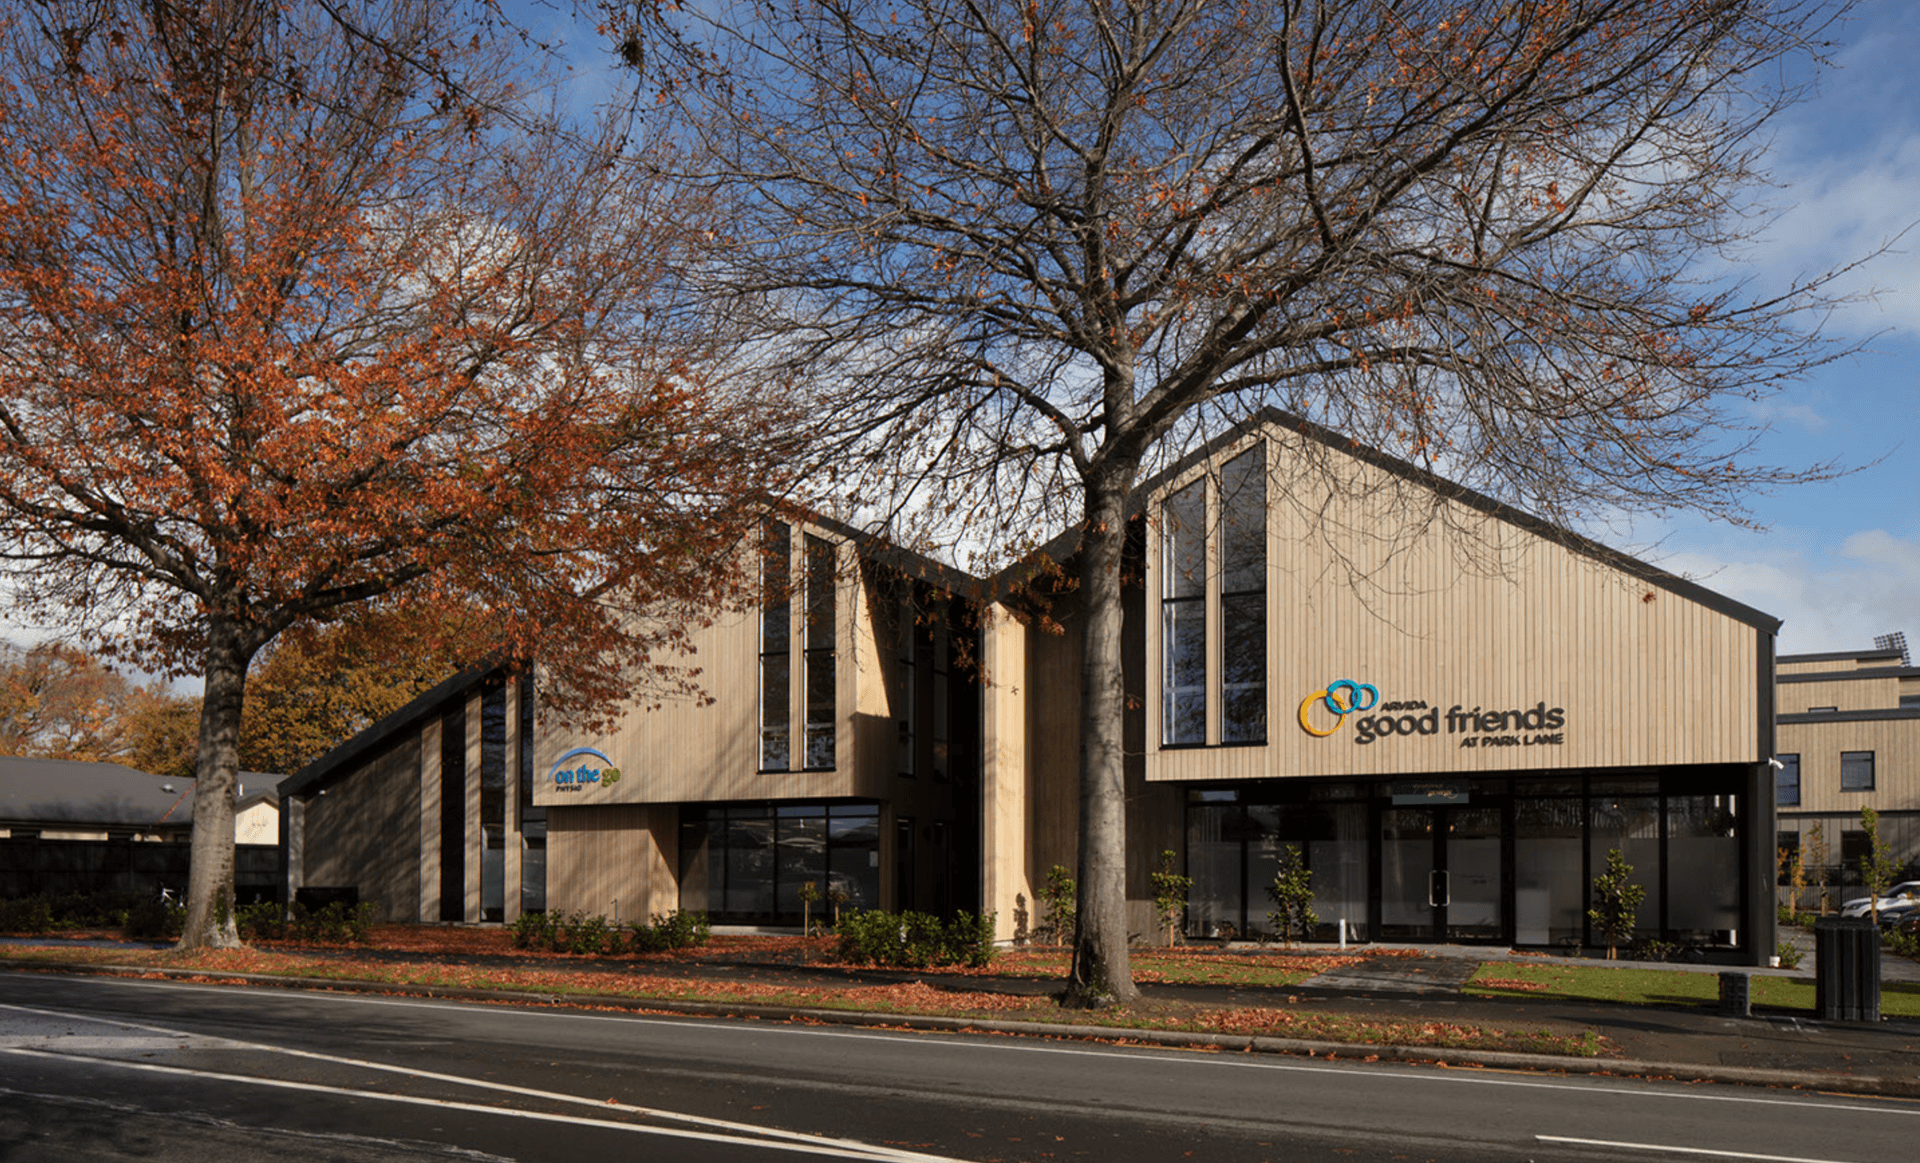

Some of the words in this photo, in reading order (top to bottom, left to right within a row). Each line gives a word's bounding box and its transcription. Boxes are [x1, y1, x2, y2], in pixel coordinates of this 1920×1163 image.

[1380, 700, 1428, 712] ARVIDA
[1355, 706, 1439, 745] good
[1444, 701, 1565, 734] friends
[1460, 736, 1480, 749] AT
[1481, 735, 1521, 748] PARK
[1522, 733, 1565, 746] LANE
[555, 770, 574, 784] on
[577, 764, 600, 783] the
[602, 768, 621, 787] go
